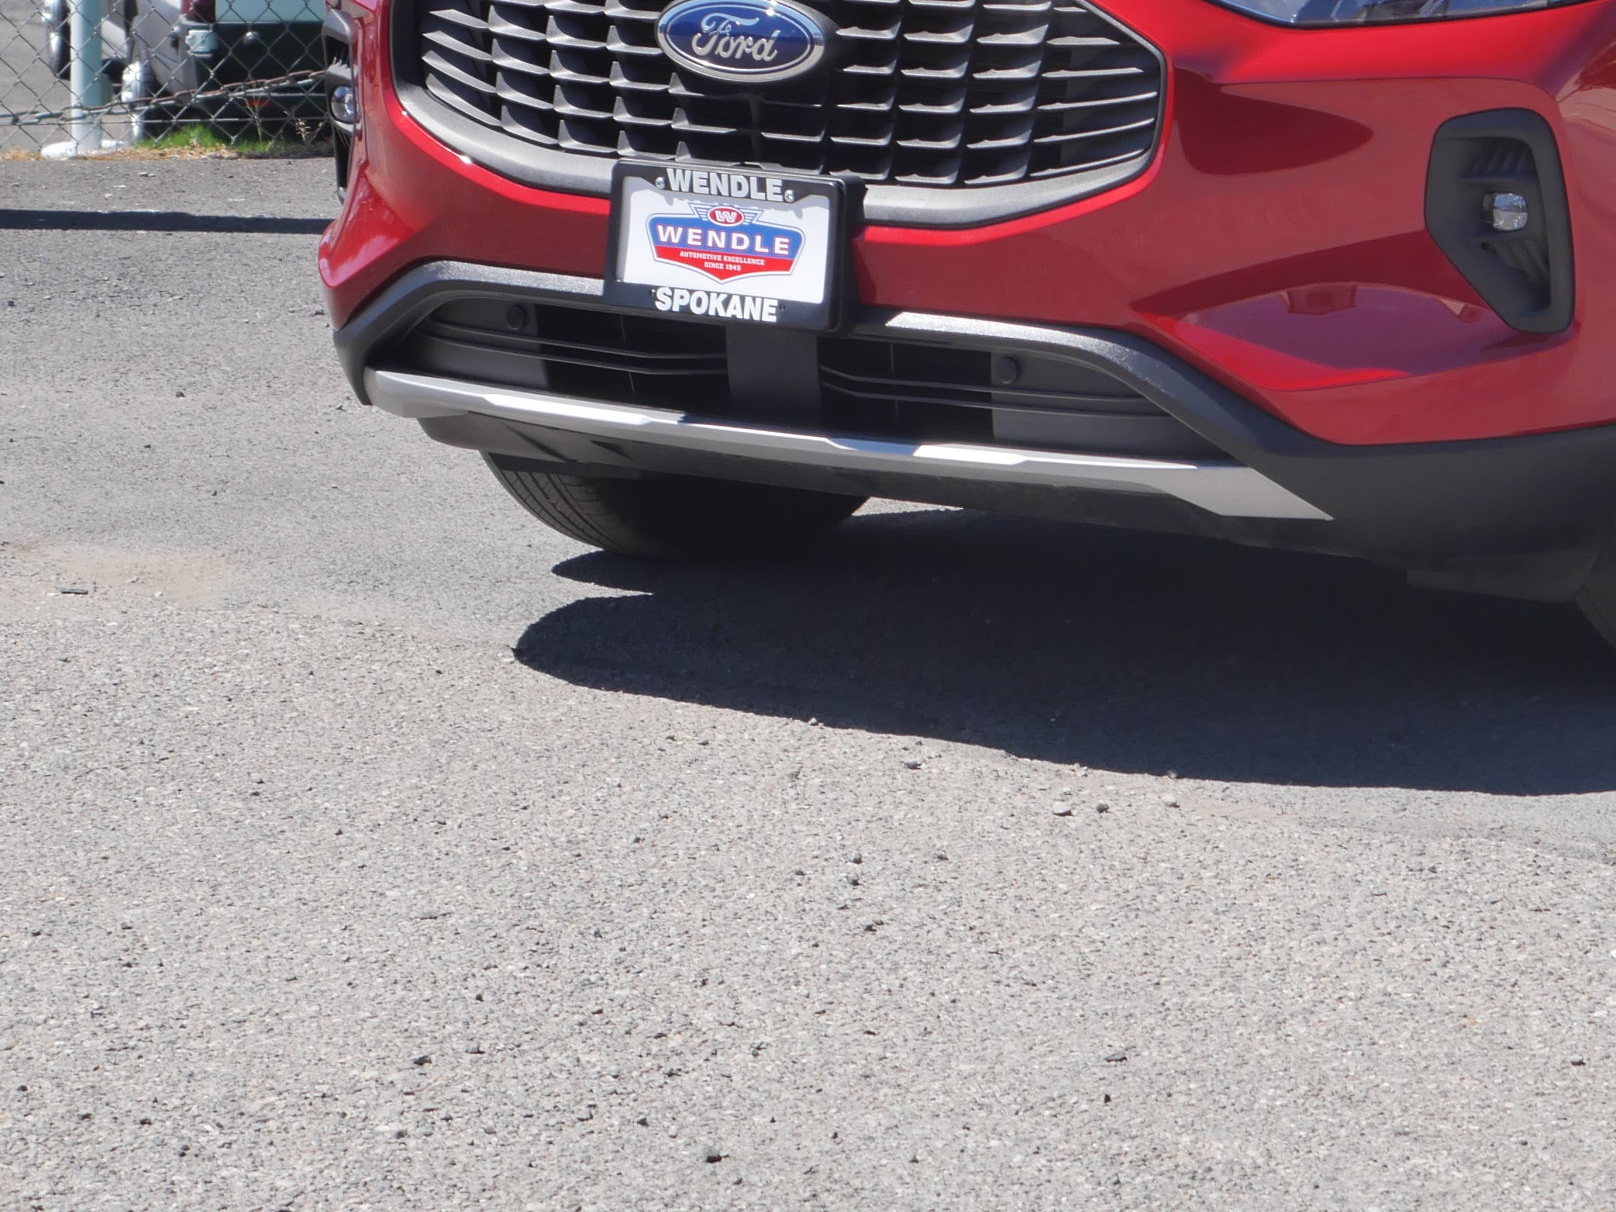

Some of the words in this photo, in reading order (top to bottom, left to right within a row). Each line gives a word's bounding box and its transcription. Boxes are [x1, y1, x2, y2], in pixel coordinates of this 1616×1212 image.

[691, 12, 781, 61] Ford
[667, 168, 783, 202] WENDLE
[657, 225, 790, 255] WENDLE
[680, 251, 722, 261] AUTOMOTIVE
[723, 255, 765, 266] EXCELLENCE
[704, 261, 725, 269] SINCE
[654, 286, 778, 323] SPOKANE
